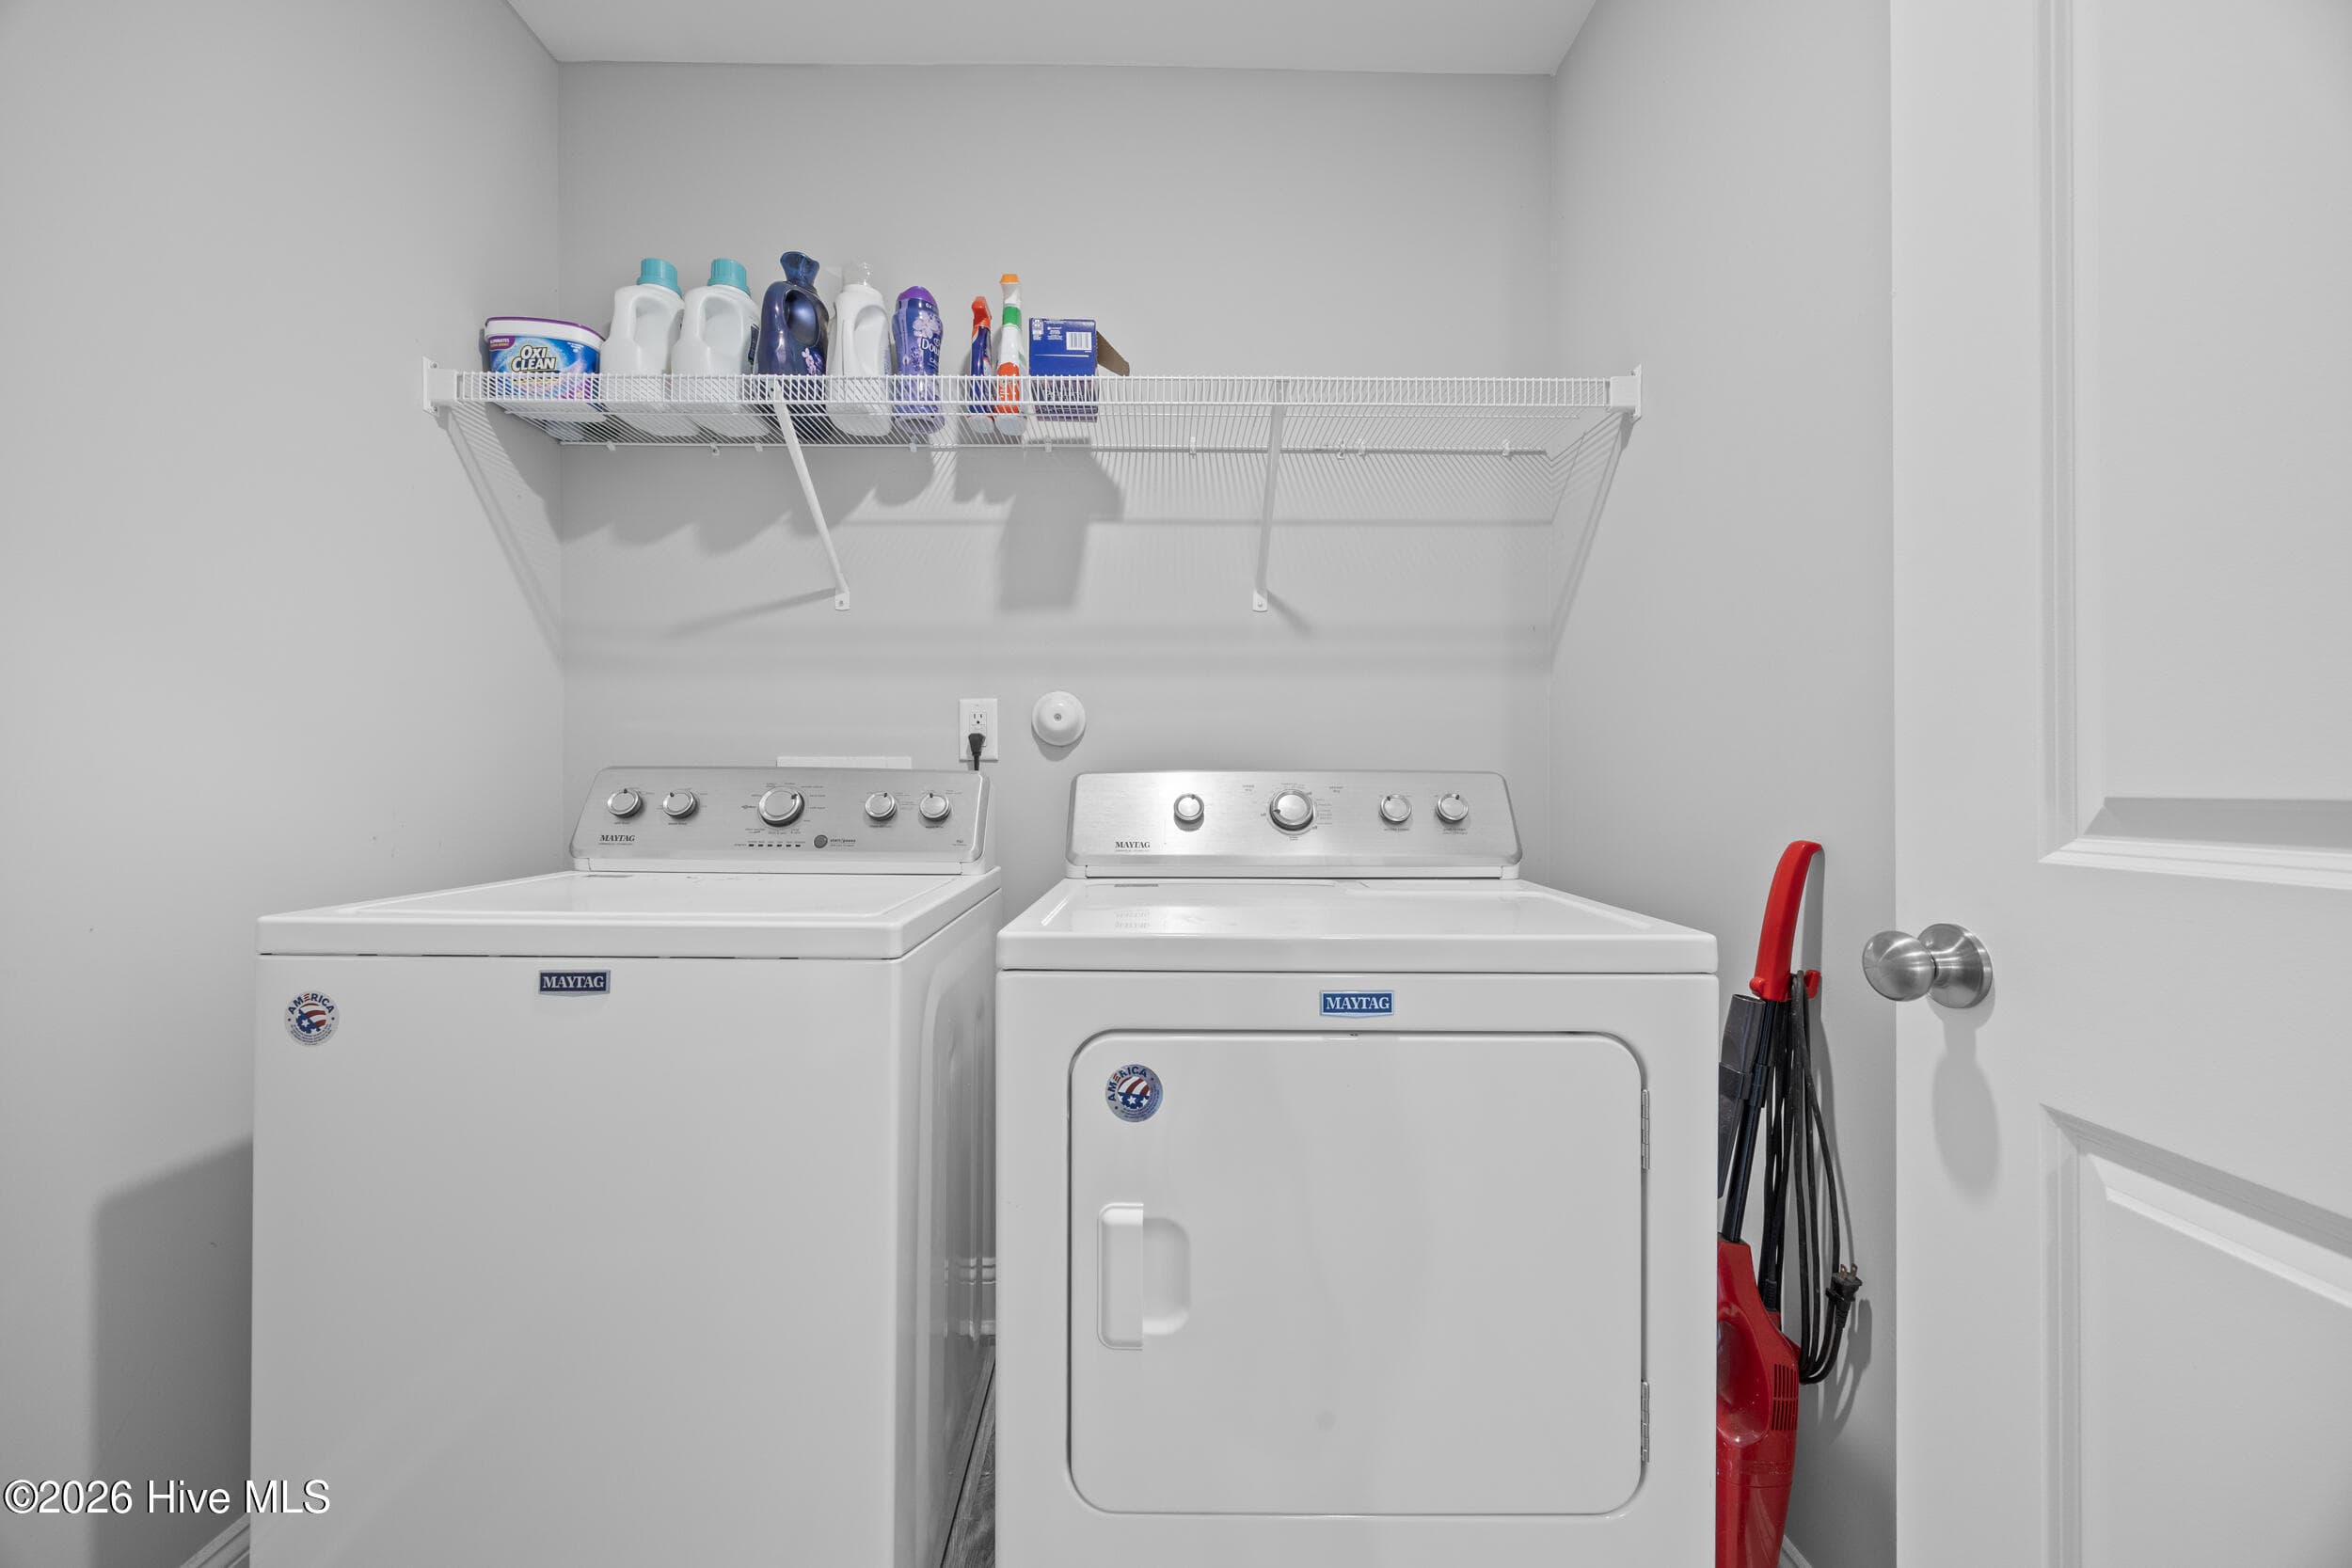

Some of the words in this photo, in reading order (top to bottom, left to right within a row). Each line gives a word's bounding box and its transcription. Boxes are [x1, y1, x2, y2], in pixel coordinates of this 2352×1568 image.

[520, 345, 548, 359] OXI
[511, 356, 557, 372] CLEAN
[542, 975, 604, 989] MAYTAG
[288, 992, 335, 1015] AMERICA
[1326, 996, 1391, 1009] MAYTAG
[1107, 1066, 1147, 1101] AMERICA
